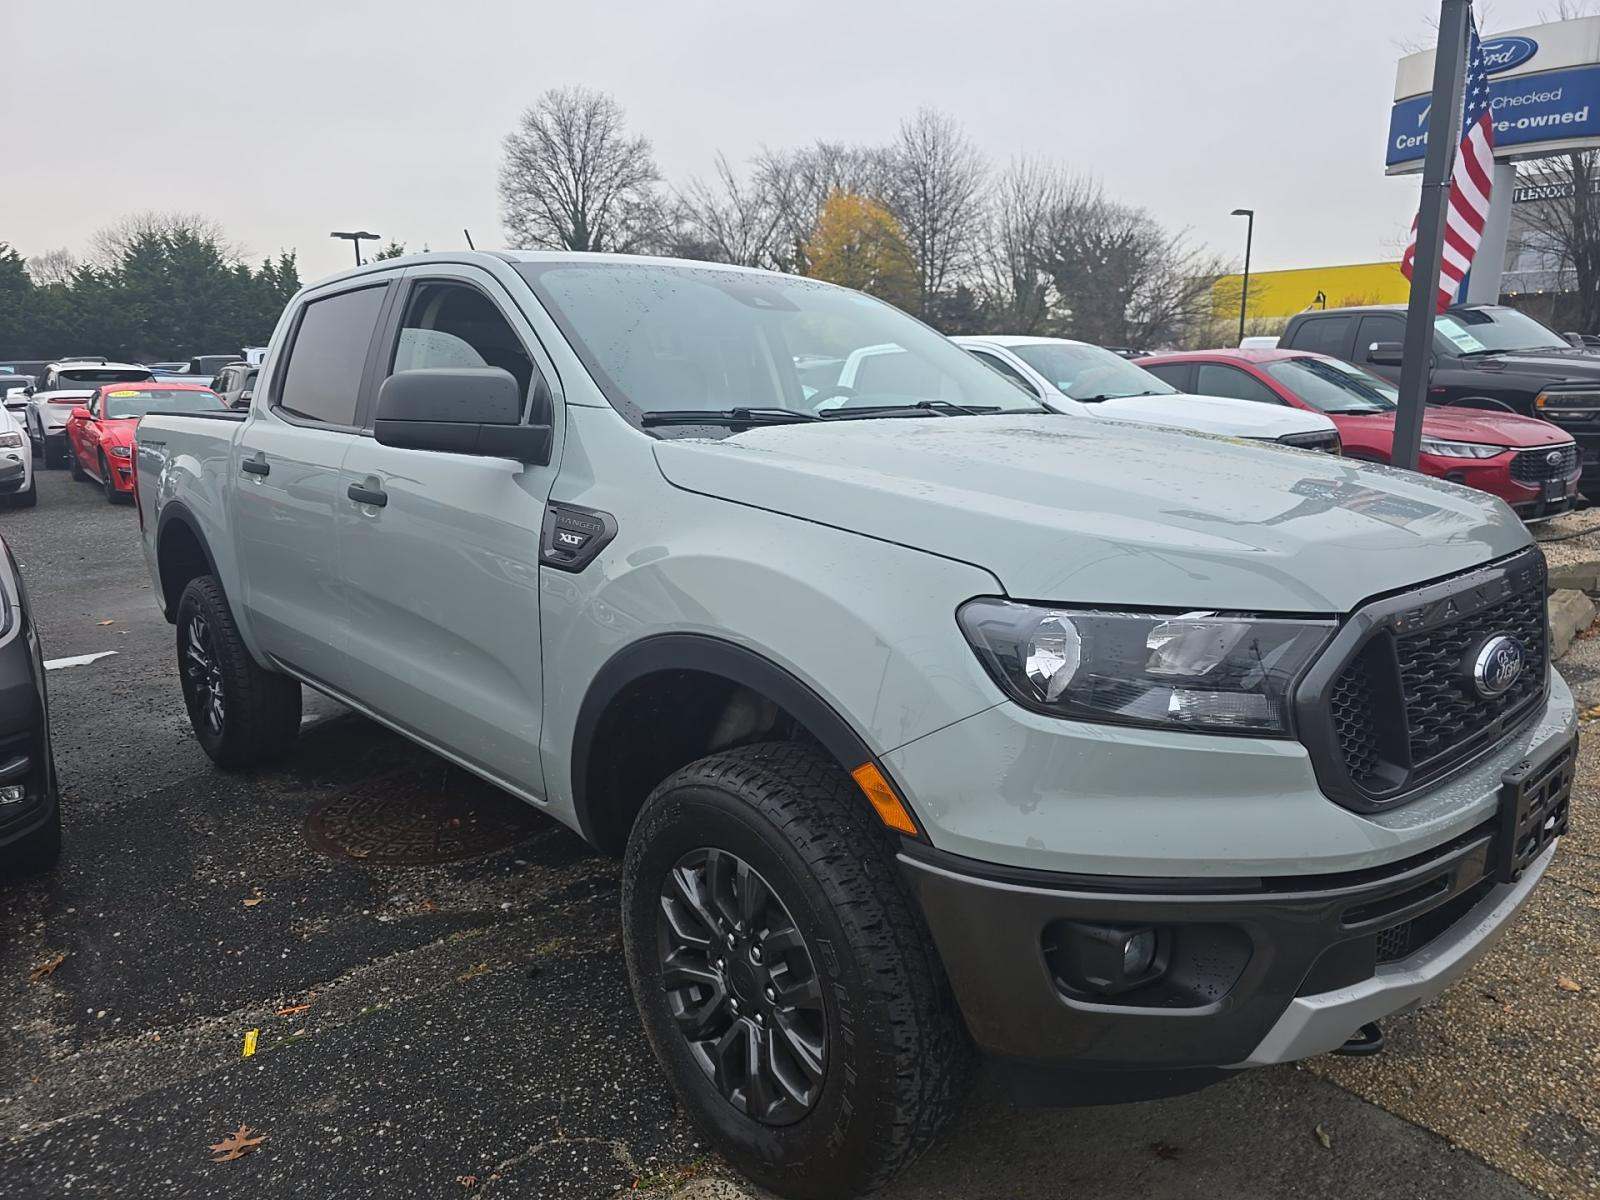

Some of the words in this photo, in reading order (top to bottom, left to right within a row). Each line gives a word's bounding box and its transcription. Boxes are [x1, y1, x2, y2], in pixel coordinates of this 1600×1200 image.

[1491, 87, 1562, 109] Checked
[1396, 131, 1429, 150] Cert
[1492, 106, 1589, 132] re-owned
[557, 516, 601, 531] RANGER
[559, 532, 583, 545] XLT
